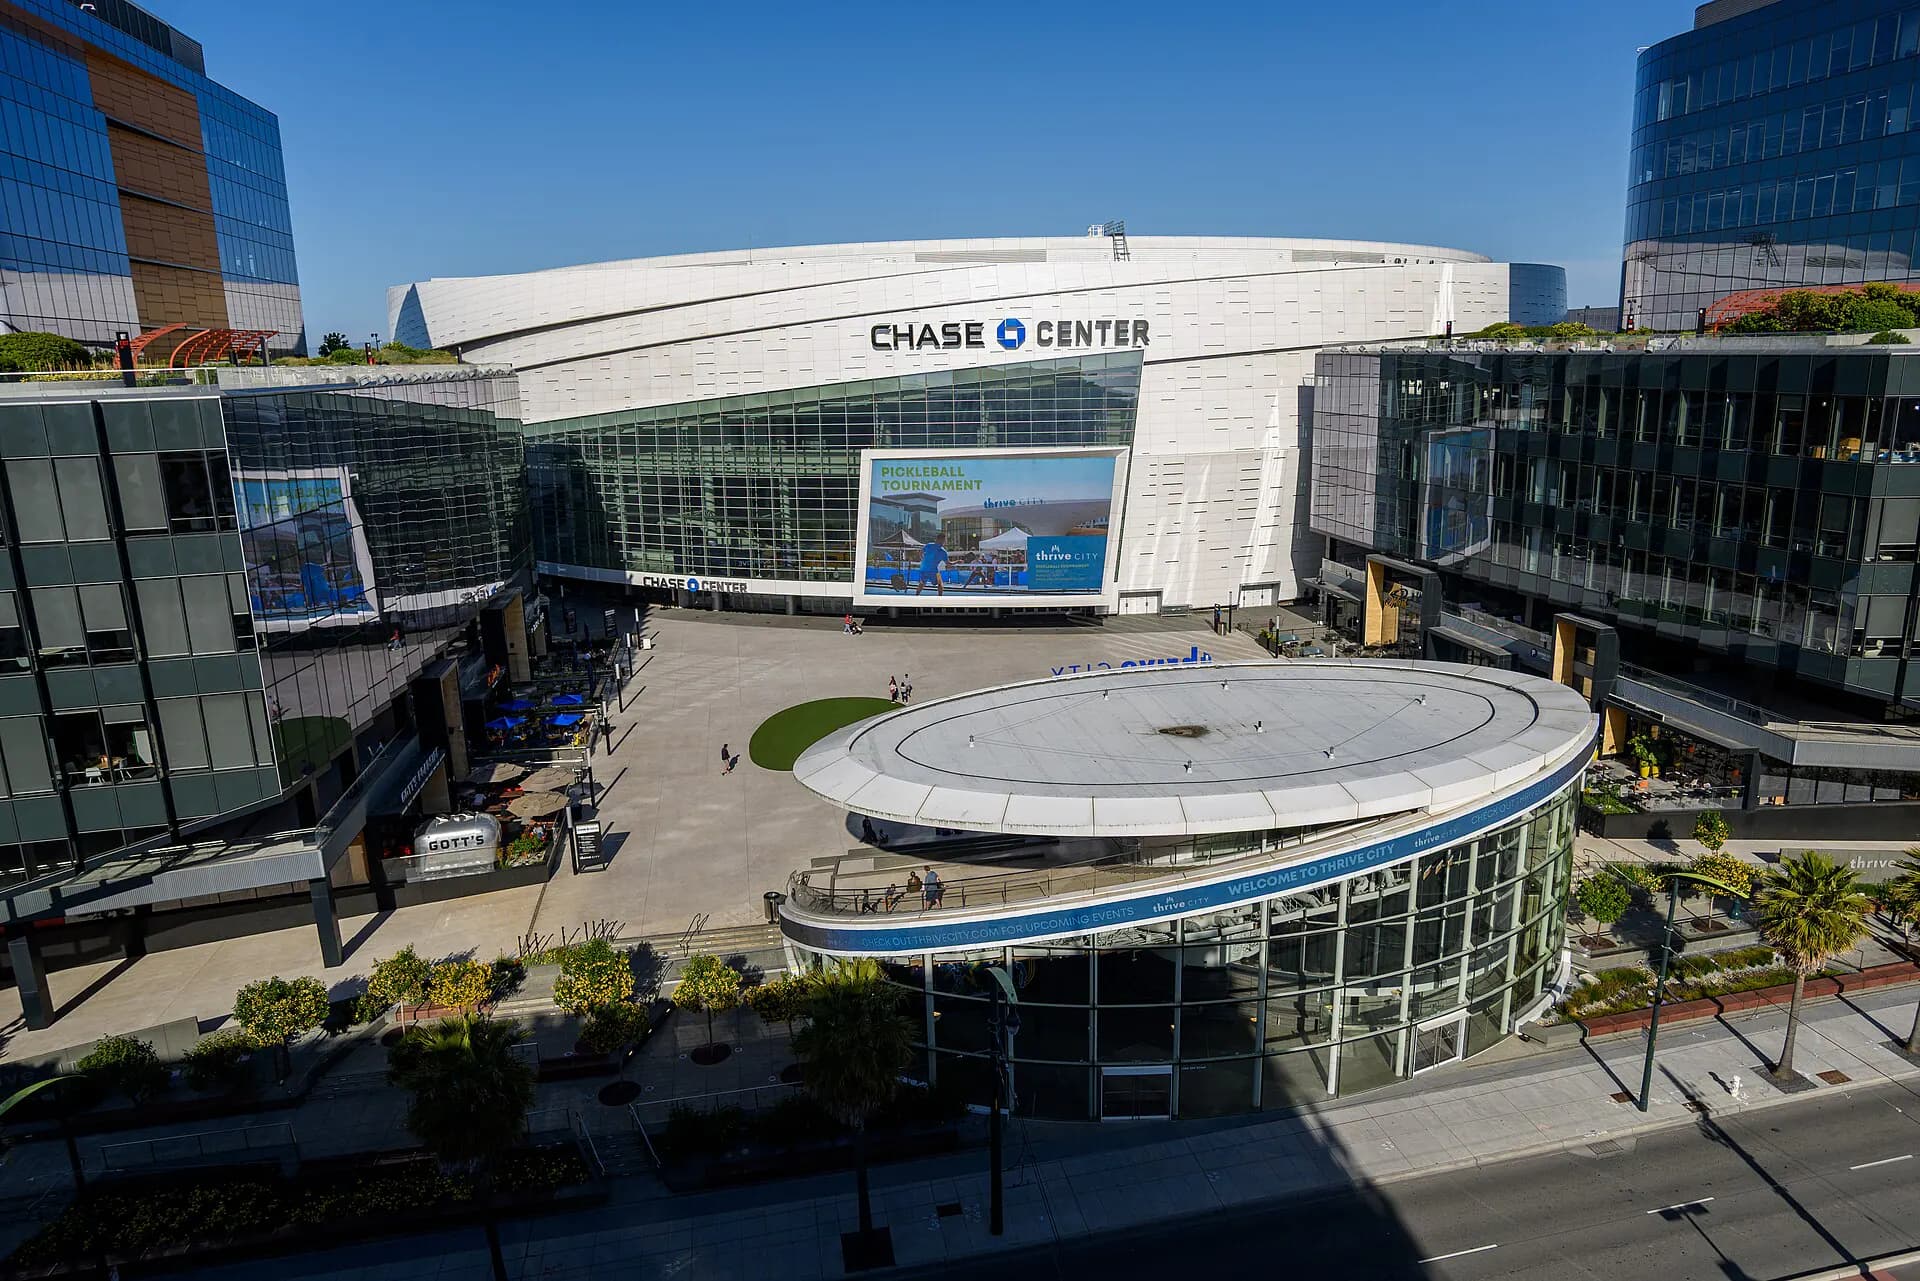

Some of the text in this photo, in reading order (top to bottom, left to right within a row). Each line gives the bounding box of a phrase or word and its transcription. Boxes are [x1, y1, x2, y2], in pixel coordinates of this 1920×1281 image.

[870, 319, 1150, 350] CHASE CENTER
[881, 466, 965, 478] PICKLEBALL
[881, 479, 983, 491] TOURNAMENT
[1035, 550, 1099, 561] thrive CITY
[643, 576, 748, 593] CHASE CENTER
[428, 835, 485, 851] GOTT'S
[1415, 835, 1440, 848] thrive
[1228, 843, 1395, 896] WELCOME TO THRIVE CITY
[1850, 856, 1897, 869] thrive
[1153, 896, 1209, 913] thrive CITY
[1001, 925, 1023, 937] FOR
[1025, 914, 1089, 933] UPCOMING
[1092, 906, 1135, 922] EVENTS
